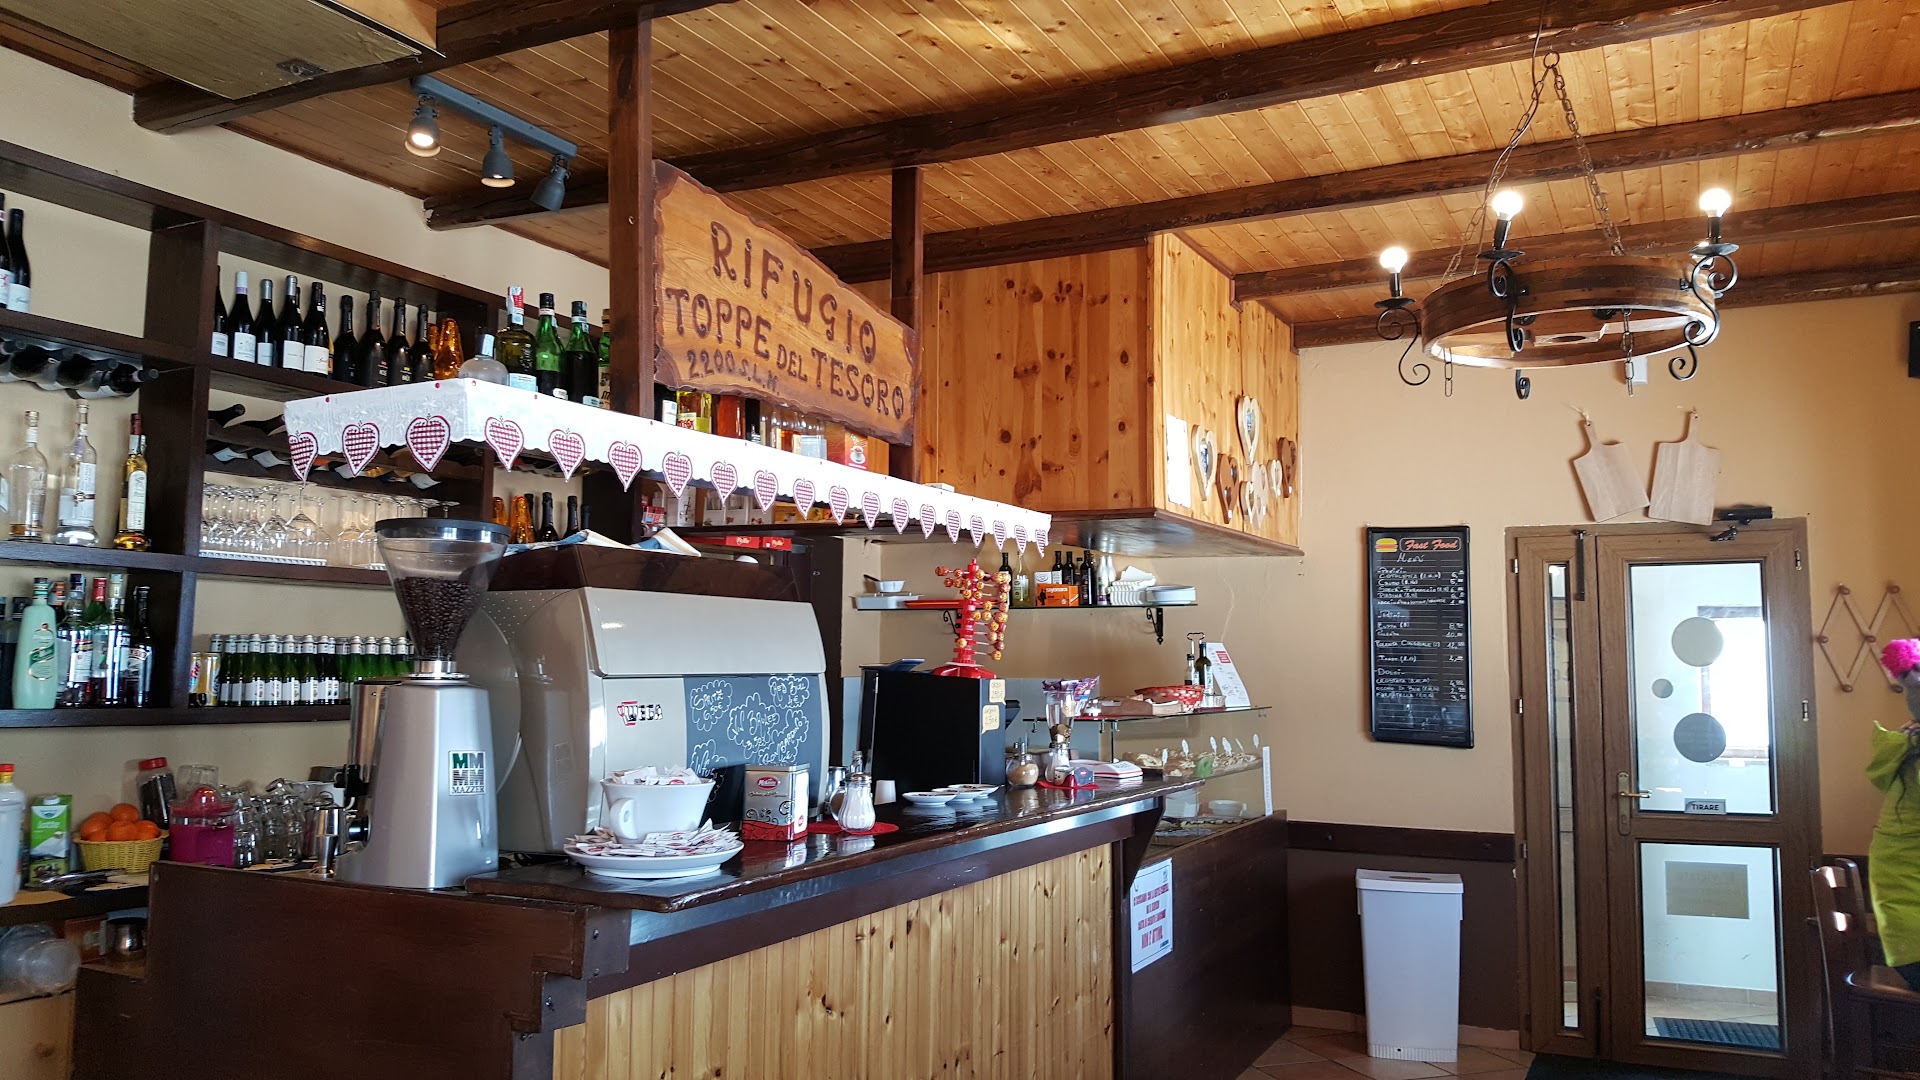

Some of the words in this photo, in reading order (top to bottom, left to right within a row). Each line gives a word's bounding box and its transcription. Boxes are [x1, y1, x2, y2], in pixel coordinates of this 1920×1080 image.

[665, 288, 772, 360] TOPPE
[776, 343, 808, 382] DEL
[811, 347, 904, 420] TESORO
[1404, 540, 1429, 550] Fast
[1432, 539, 1457, 550] Food
[621, 702, 663, 724] WEGA
[452, 786, 485, 794] MAZZER
